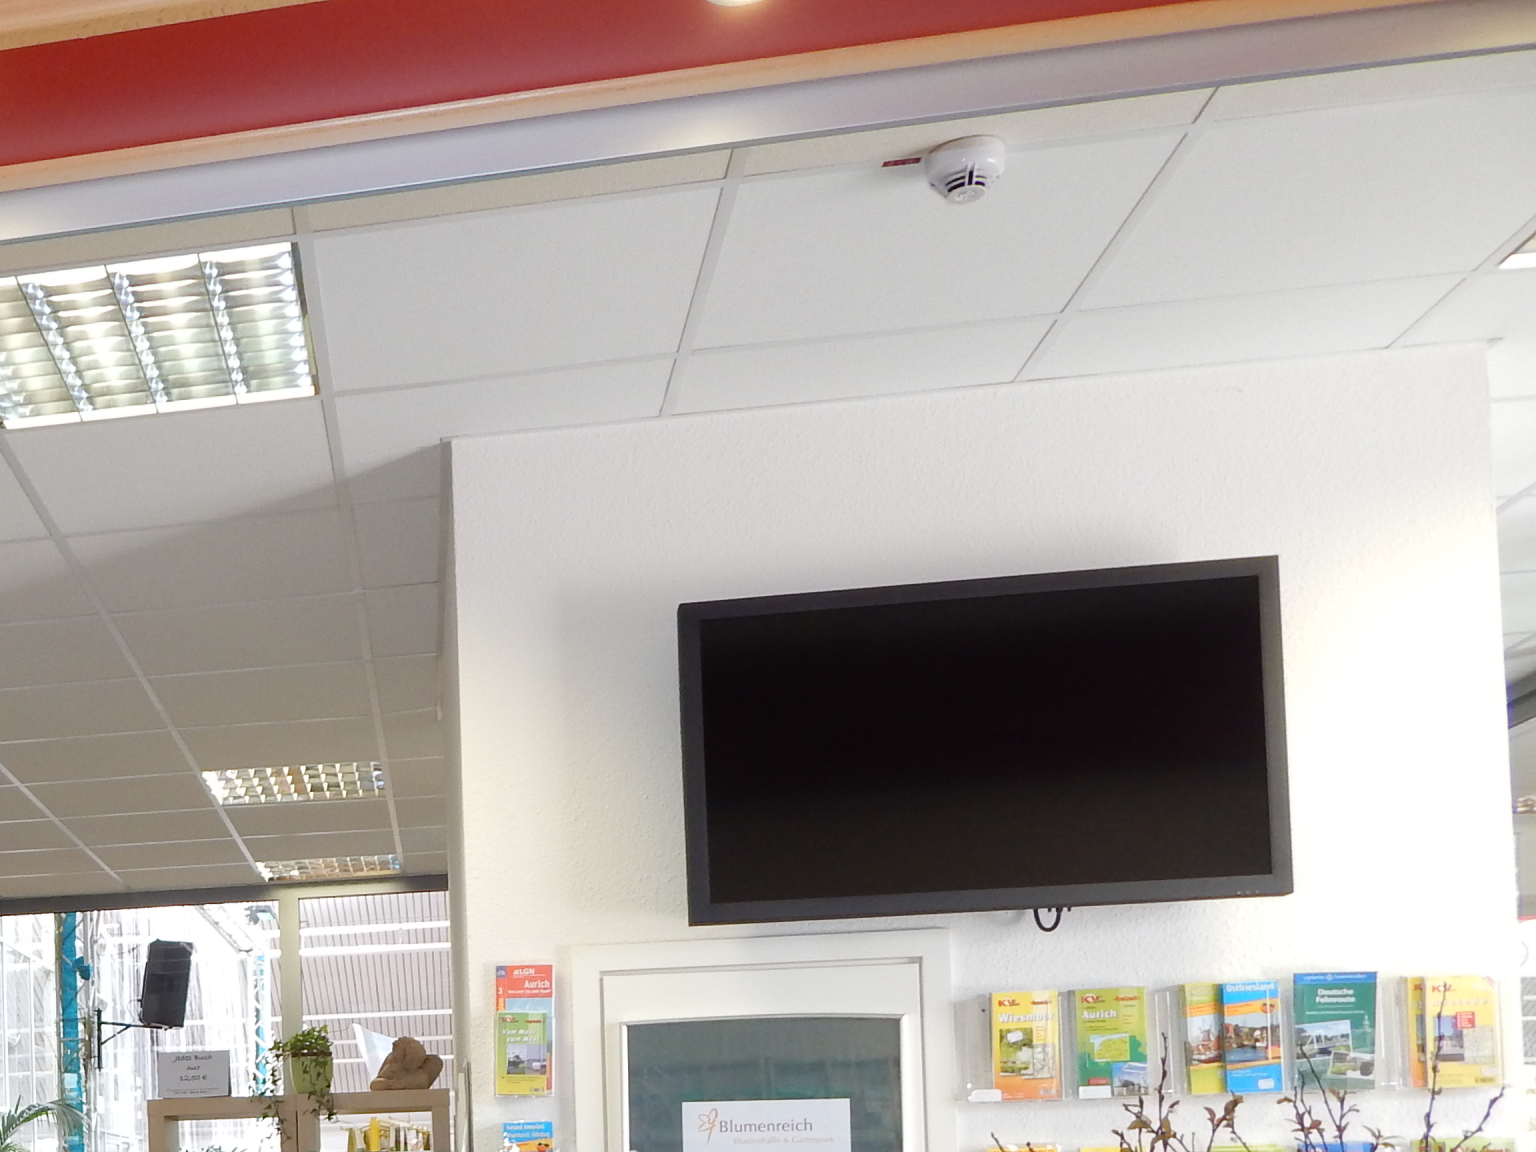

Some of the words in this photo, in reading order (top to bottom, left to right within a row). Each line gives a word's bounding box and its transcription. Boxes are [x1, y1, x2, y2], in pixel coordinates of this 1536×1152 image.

[524, 980, 550, 988] Aurich
[1082, 1010, 1117, 1019] Aurich
[719, 1118, 813, 1133] Blumenreich
